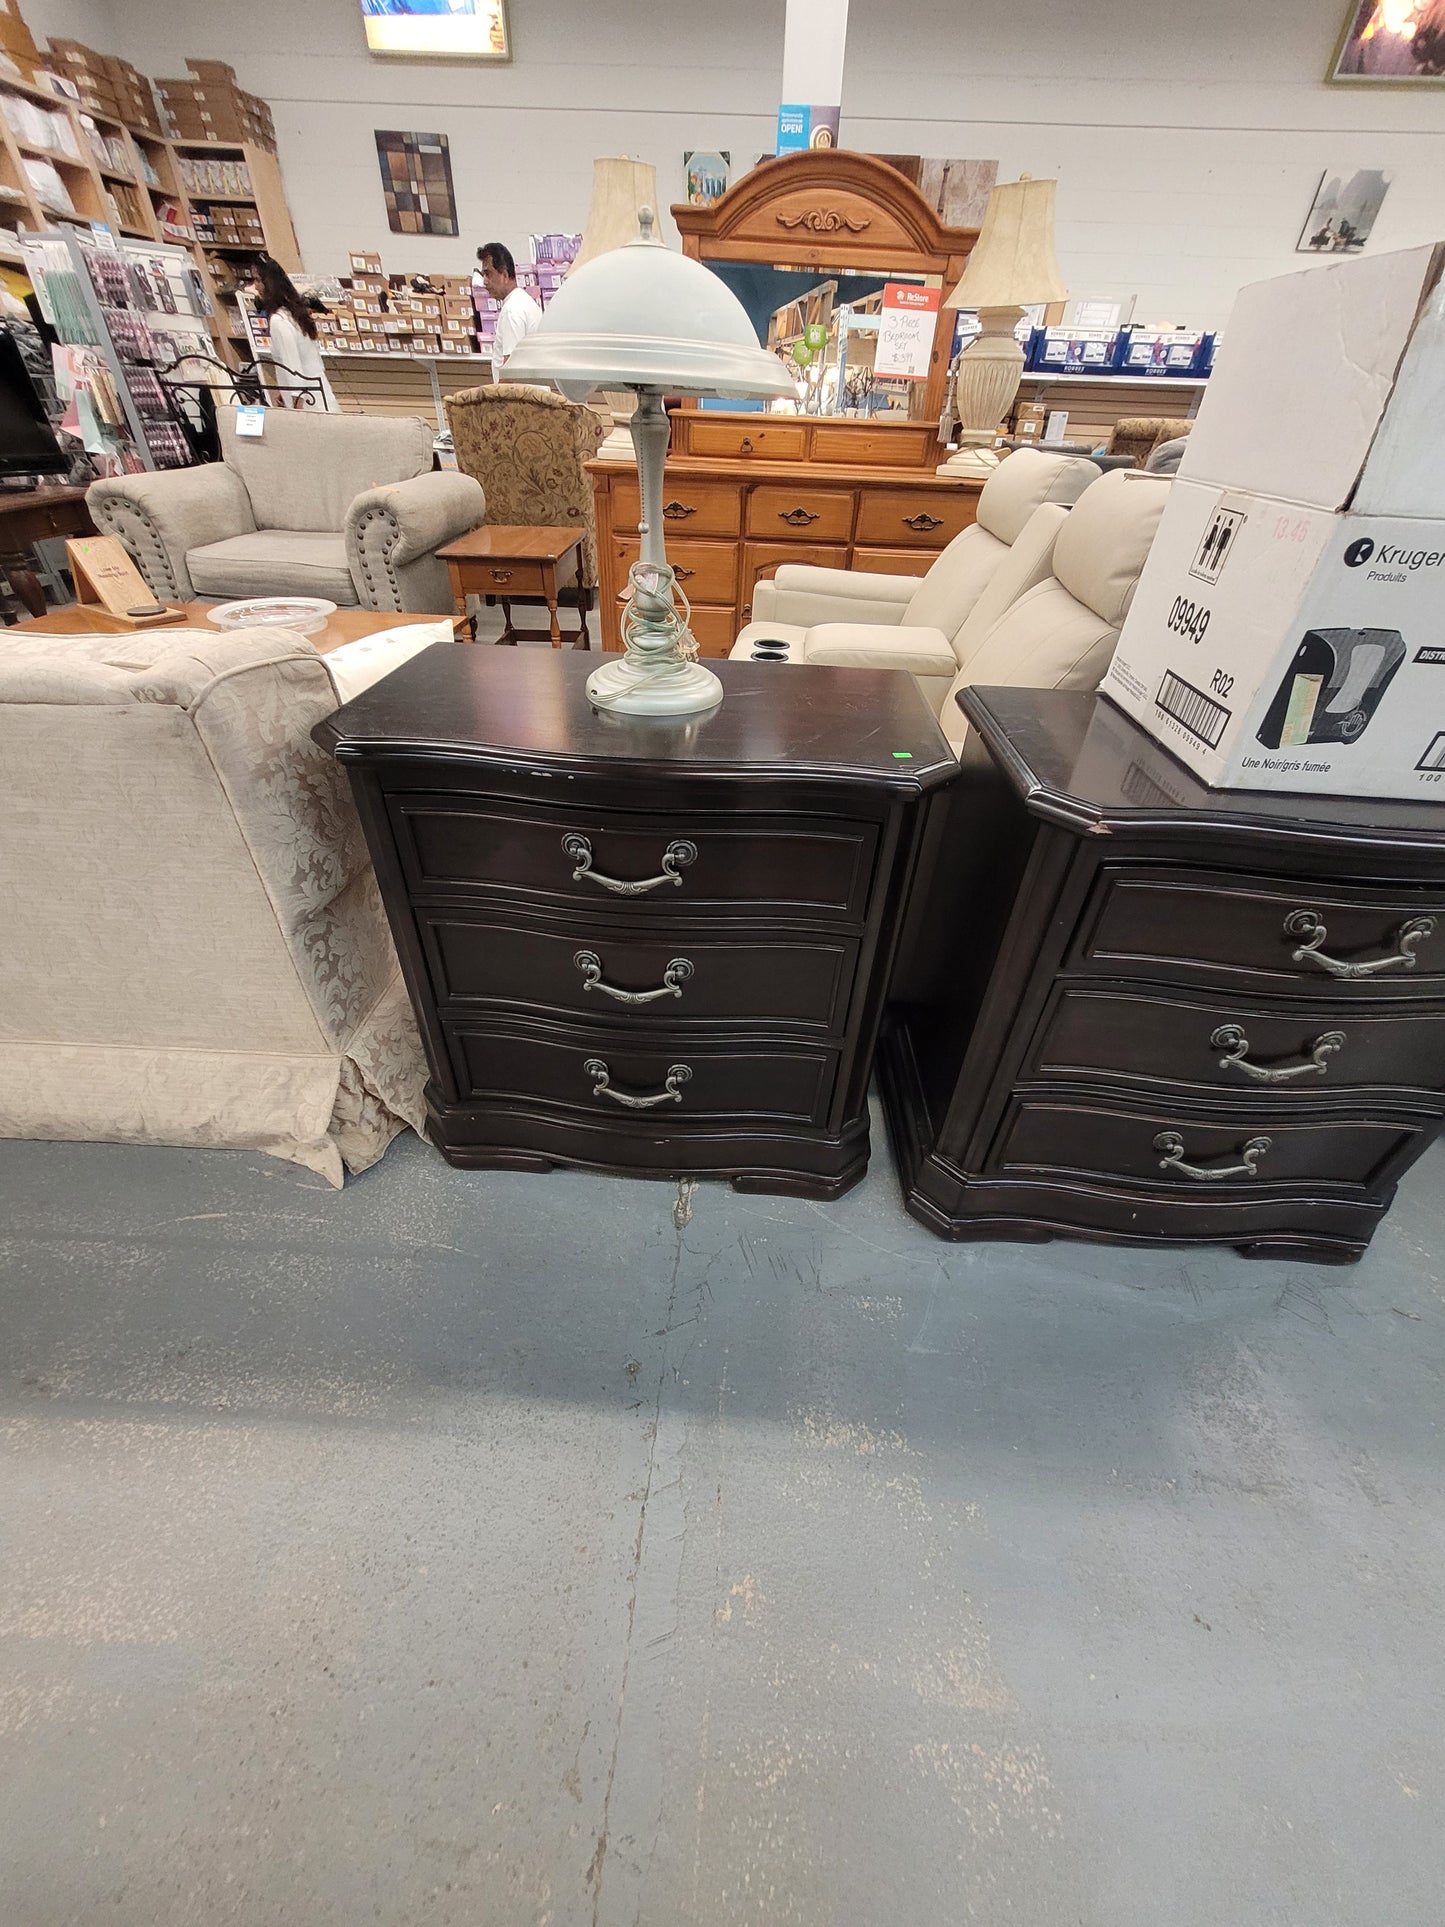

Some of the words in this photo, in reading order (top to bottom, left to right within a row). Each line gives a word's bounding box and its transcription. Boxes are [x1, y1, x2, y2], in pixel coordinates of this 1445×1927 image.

[907, 291, 929, 303] ReStore
[887, 315, 898, 329] 3
[1375, 545, 1445, 571] Kruger
[1367, 571, 1407, 582] Produits
[1167, 595, 1211, 645] 09949
[1209, 668, 1234, 698] R02
[1241, 757, 1260, 768] Une
[1261, 758, 1301, 772] Noir/gris
[1302, 760, 1331, 772] fumée
[1418, 773, 1442, 782] 100
